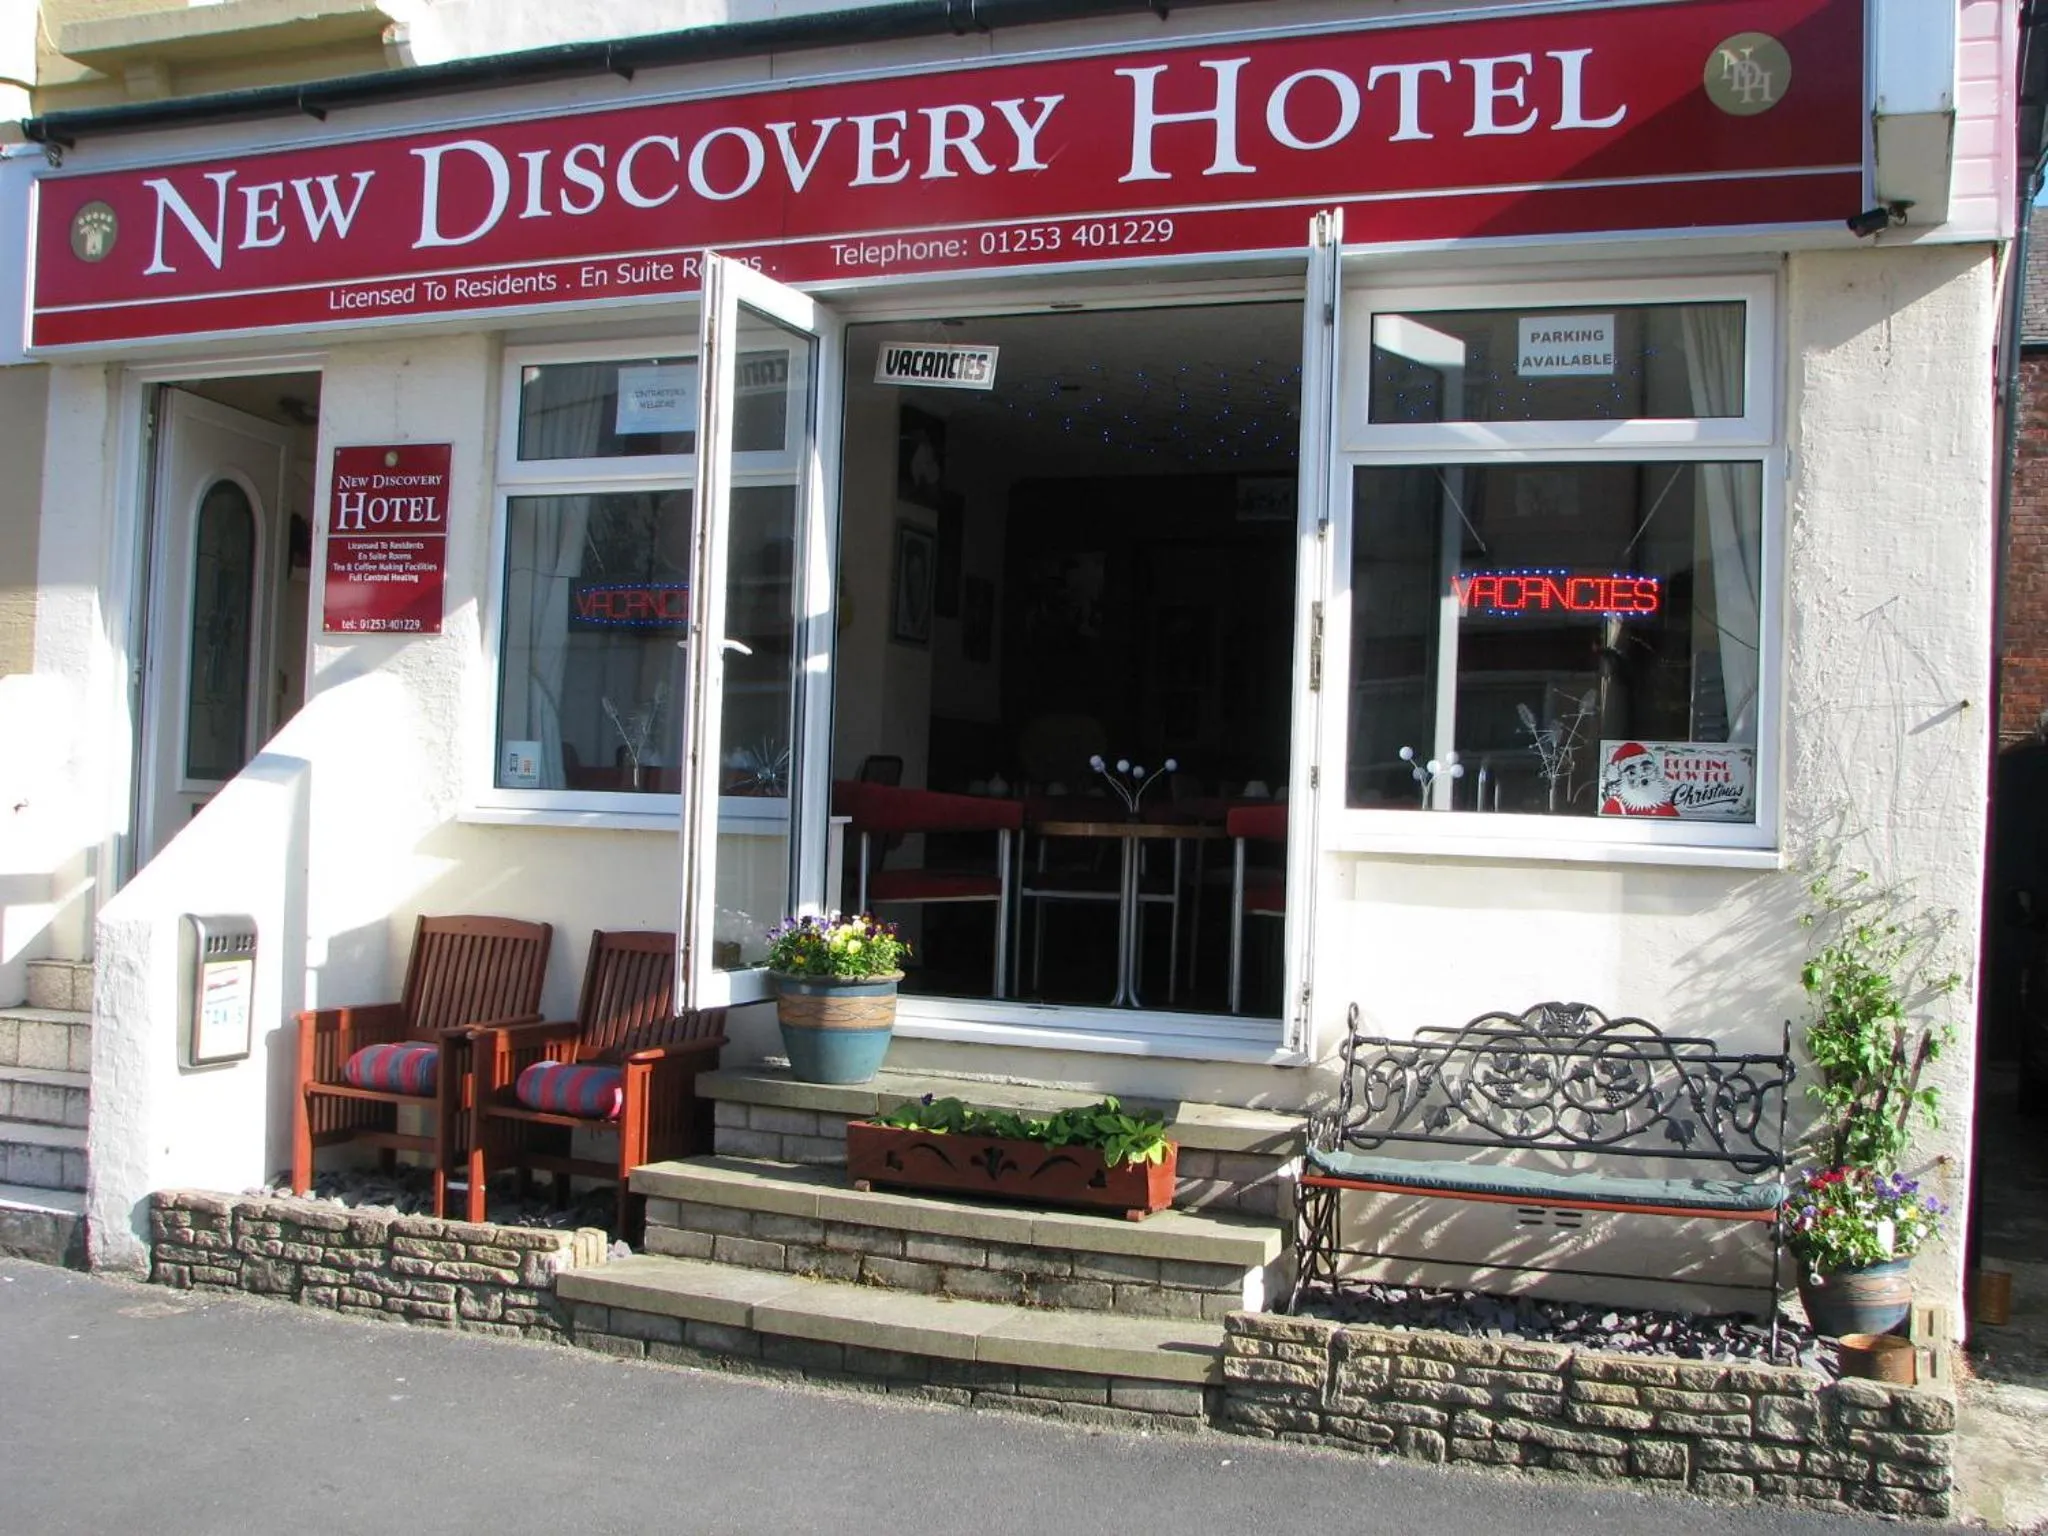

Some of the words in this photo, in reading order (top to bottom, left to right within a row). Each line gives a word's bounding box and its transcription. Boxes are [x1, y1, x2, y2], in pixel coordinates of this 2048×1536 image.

[142, 169, 375, 276] NEW
[410, 94, 1065, 249] DISCOVERY
[1114, 47, 1628, 184] HOTEL
[830, 238, 969, 269] Telephone:
[980, 227, 1061, 256] 01253
[1072, 219, 1174, 248] 401229
[328, 282, 415, 311] Licensed
[424, 282, 447, 301] To
[455, 273, 557, 299] Residents
[581, 267, 608, 288] En
[617, 260, 674, 284] Suite
[1530, 329, 1604, 344] PARKING
[885, 349, 989, 381] VACANCIES
[1522, 353, 1612, 368] AVAILABLE
[339, 476, 369, 490] NEW
[372, 474, 442, 489] DISCOVERY
[336, 492, 441, 530] HOTEL
[389, 541, 424, 550] Residents
[358, 552, 367, 560] En
[391, 573, 419, 583] Heating
[1451, 575, 1661, 612] VACANCIES
[360, 619, 386, 629] 01253
[388, 619, 420, 630] 401229
[1670, 783, 1744, 807] Christmas
